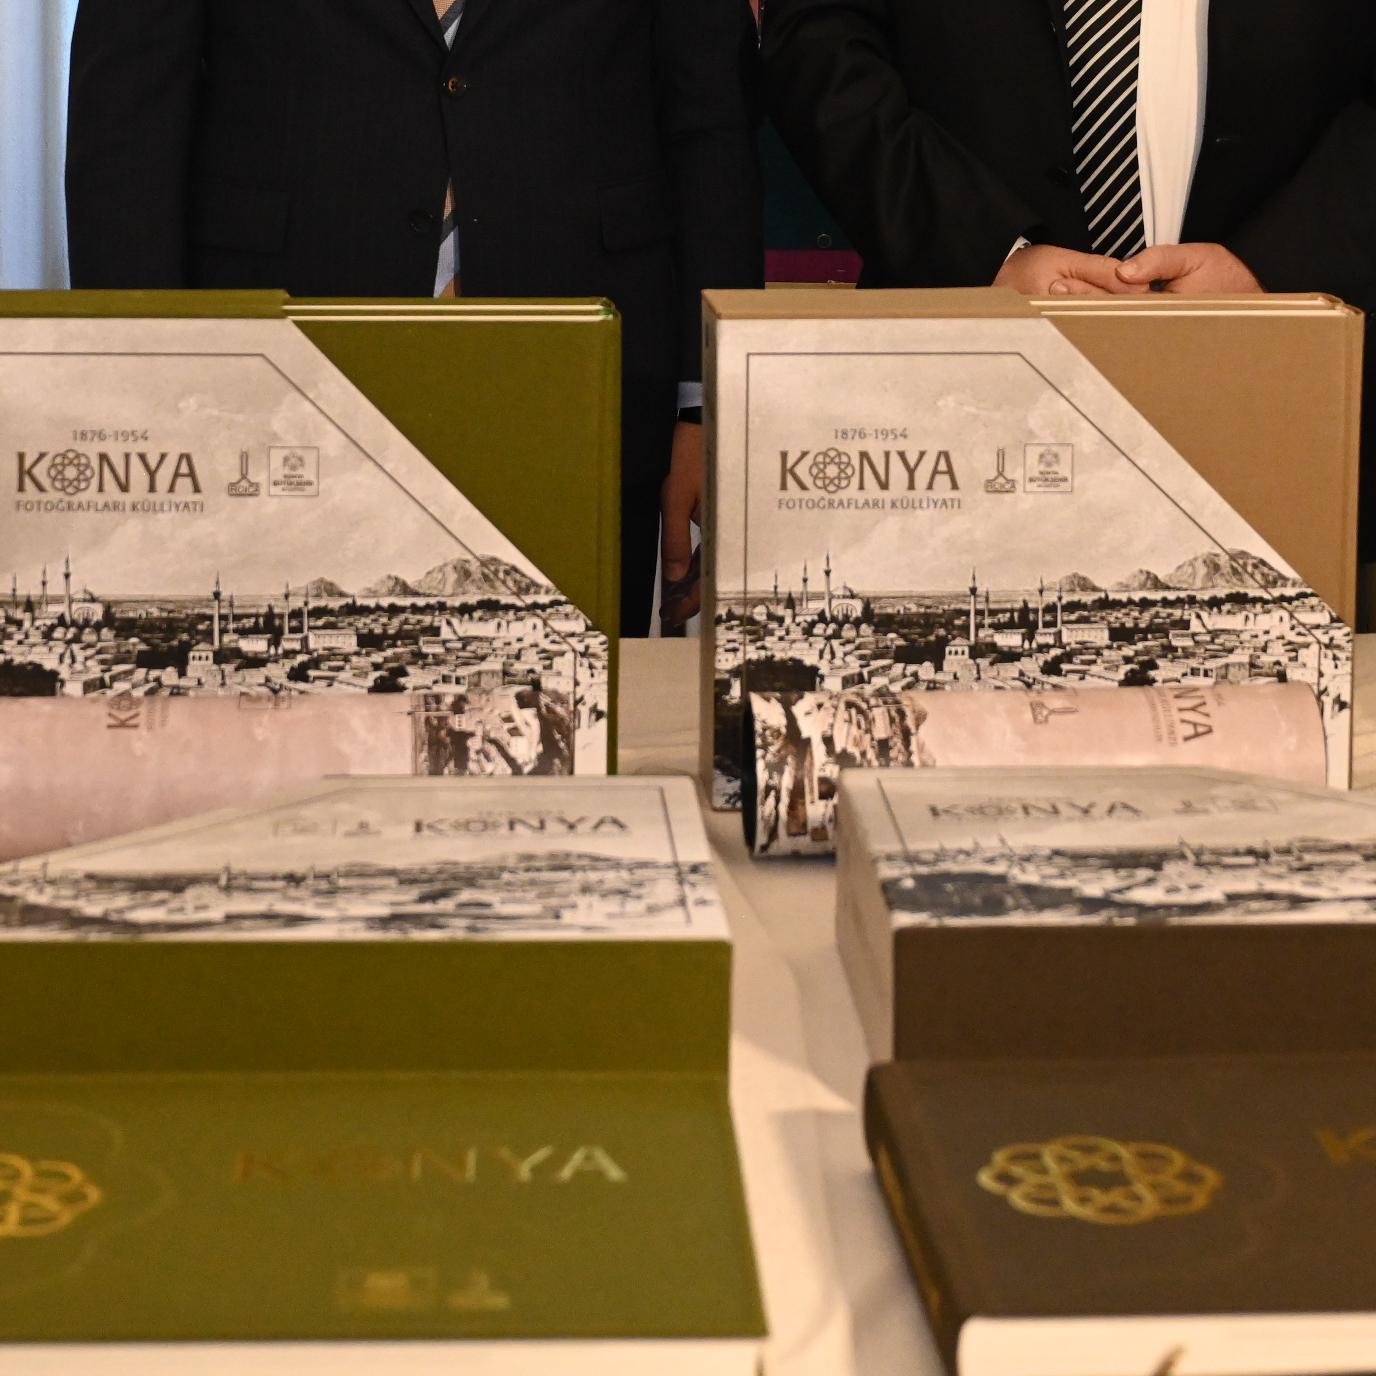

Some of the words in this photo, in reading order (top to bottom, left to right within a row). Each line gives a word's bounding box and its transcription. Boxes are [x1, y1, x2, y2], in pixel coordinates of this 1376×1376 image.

[73, 429, 149, 442] 1876-1954
[833, 427, 909, 440] 1876-1954
[17, 449, 202, 496] KONYA
[779, 447, 960, 494] KONYA
[1169, 687, 1213, 742] NYA
